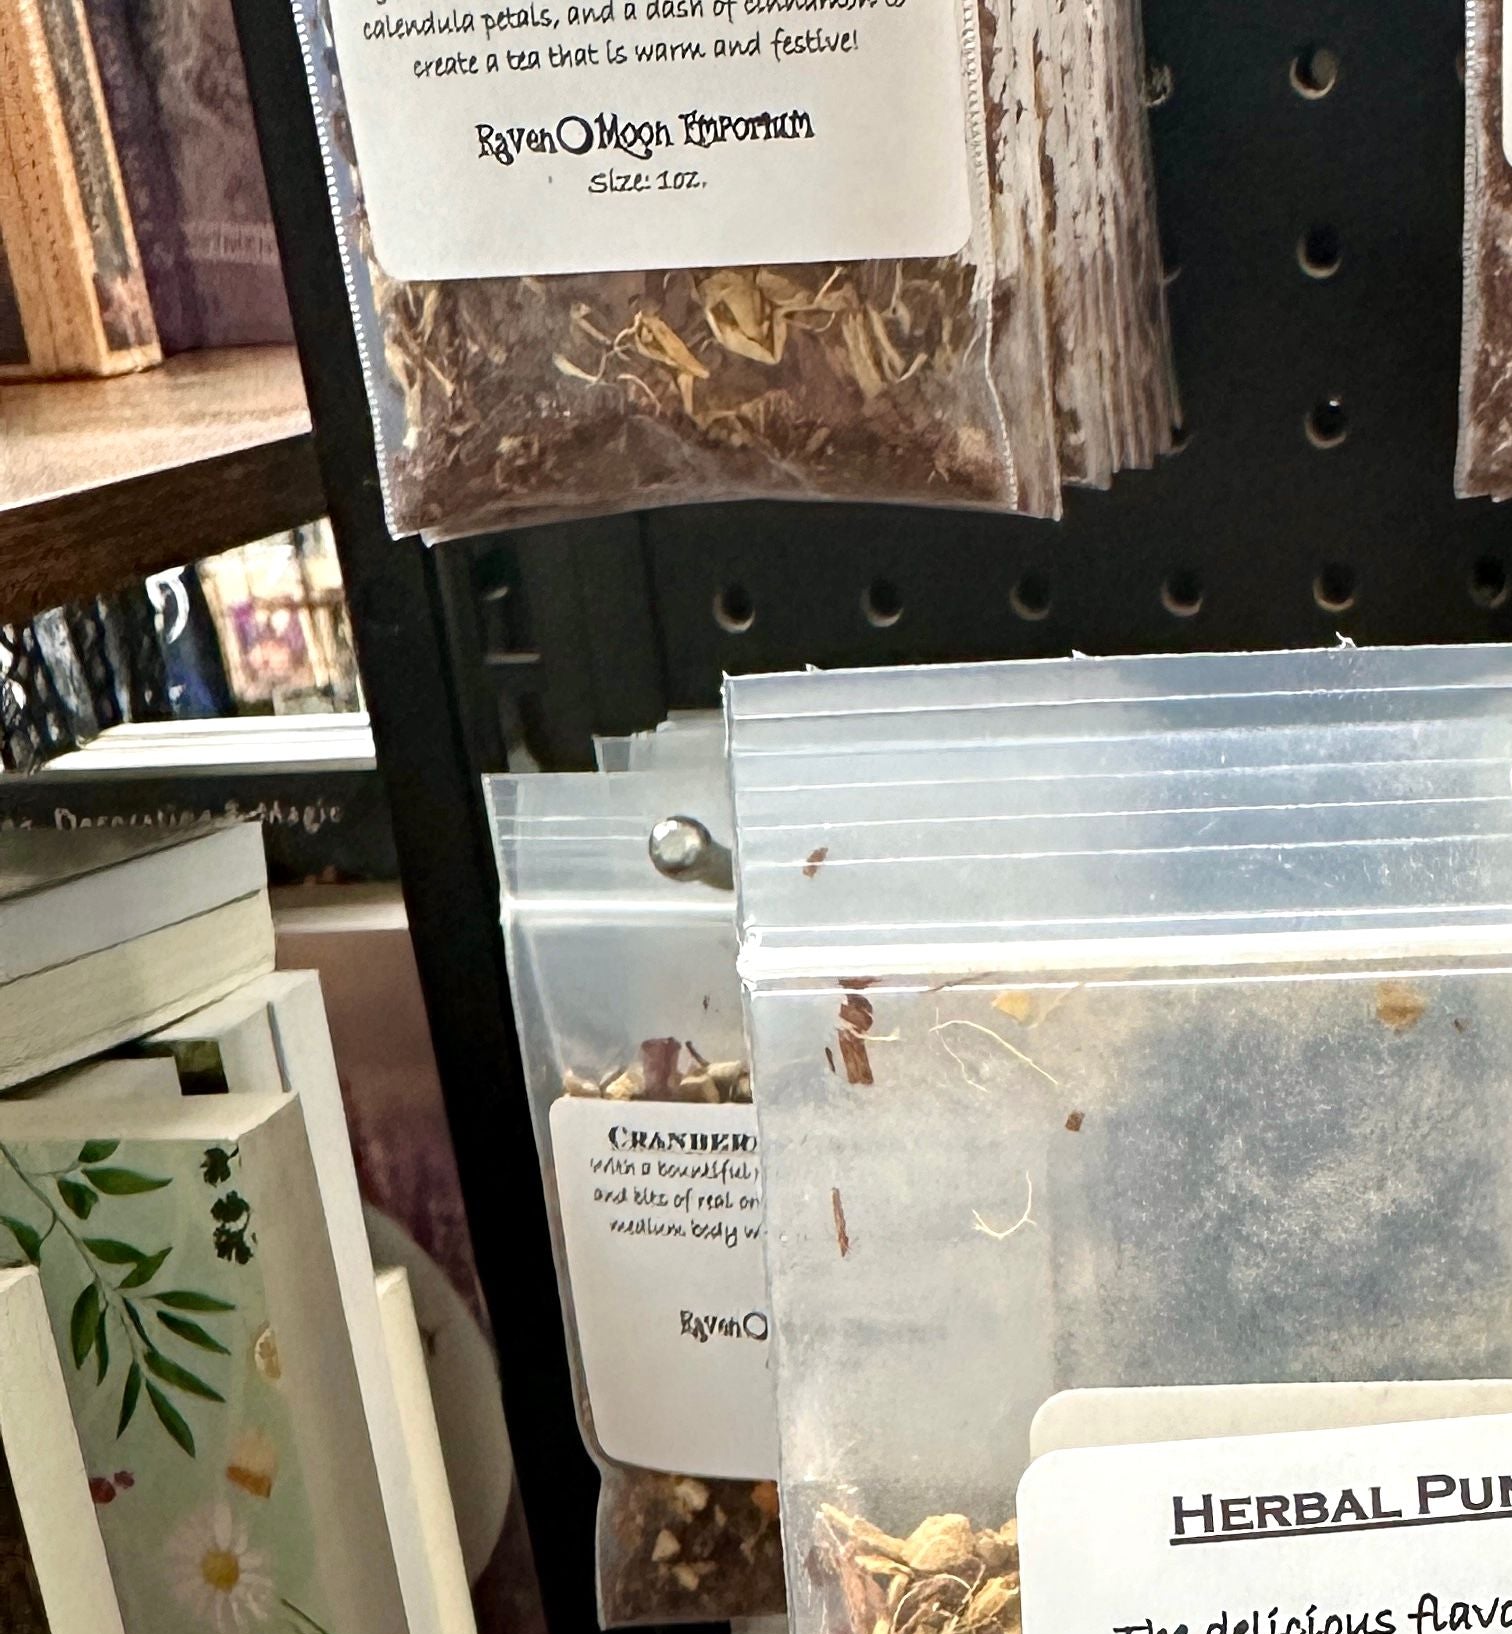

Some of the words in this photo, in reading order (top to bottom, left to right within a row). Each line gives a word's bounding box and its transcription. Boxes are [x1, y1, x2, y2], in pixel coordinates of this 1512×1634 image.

[363, 9, 475, 40] calendula
[481, 7, 560, 40] petals,
[567, 0, 615, 22] and
[624, 3, 638, 20] a
[646, 0, 704, 18] dash
[413, 53, 479, 78] create
[486, 53, 499, 72] a
[507, 50, 541, 71] tea
[549, 44, 600, 68] that
[606, 40, 628, 64] is
[635, 40, 706, 62] warm
[714, 30, 761, 56] and
[771, 27, 858, 61] festive!
[1173, 1486, 1402, 1534] HERBAL
